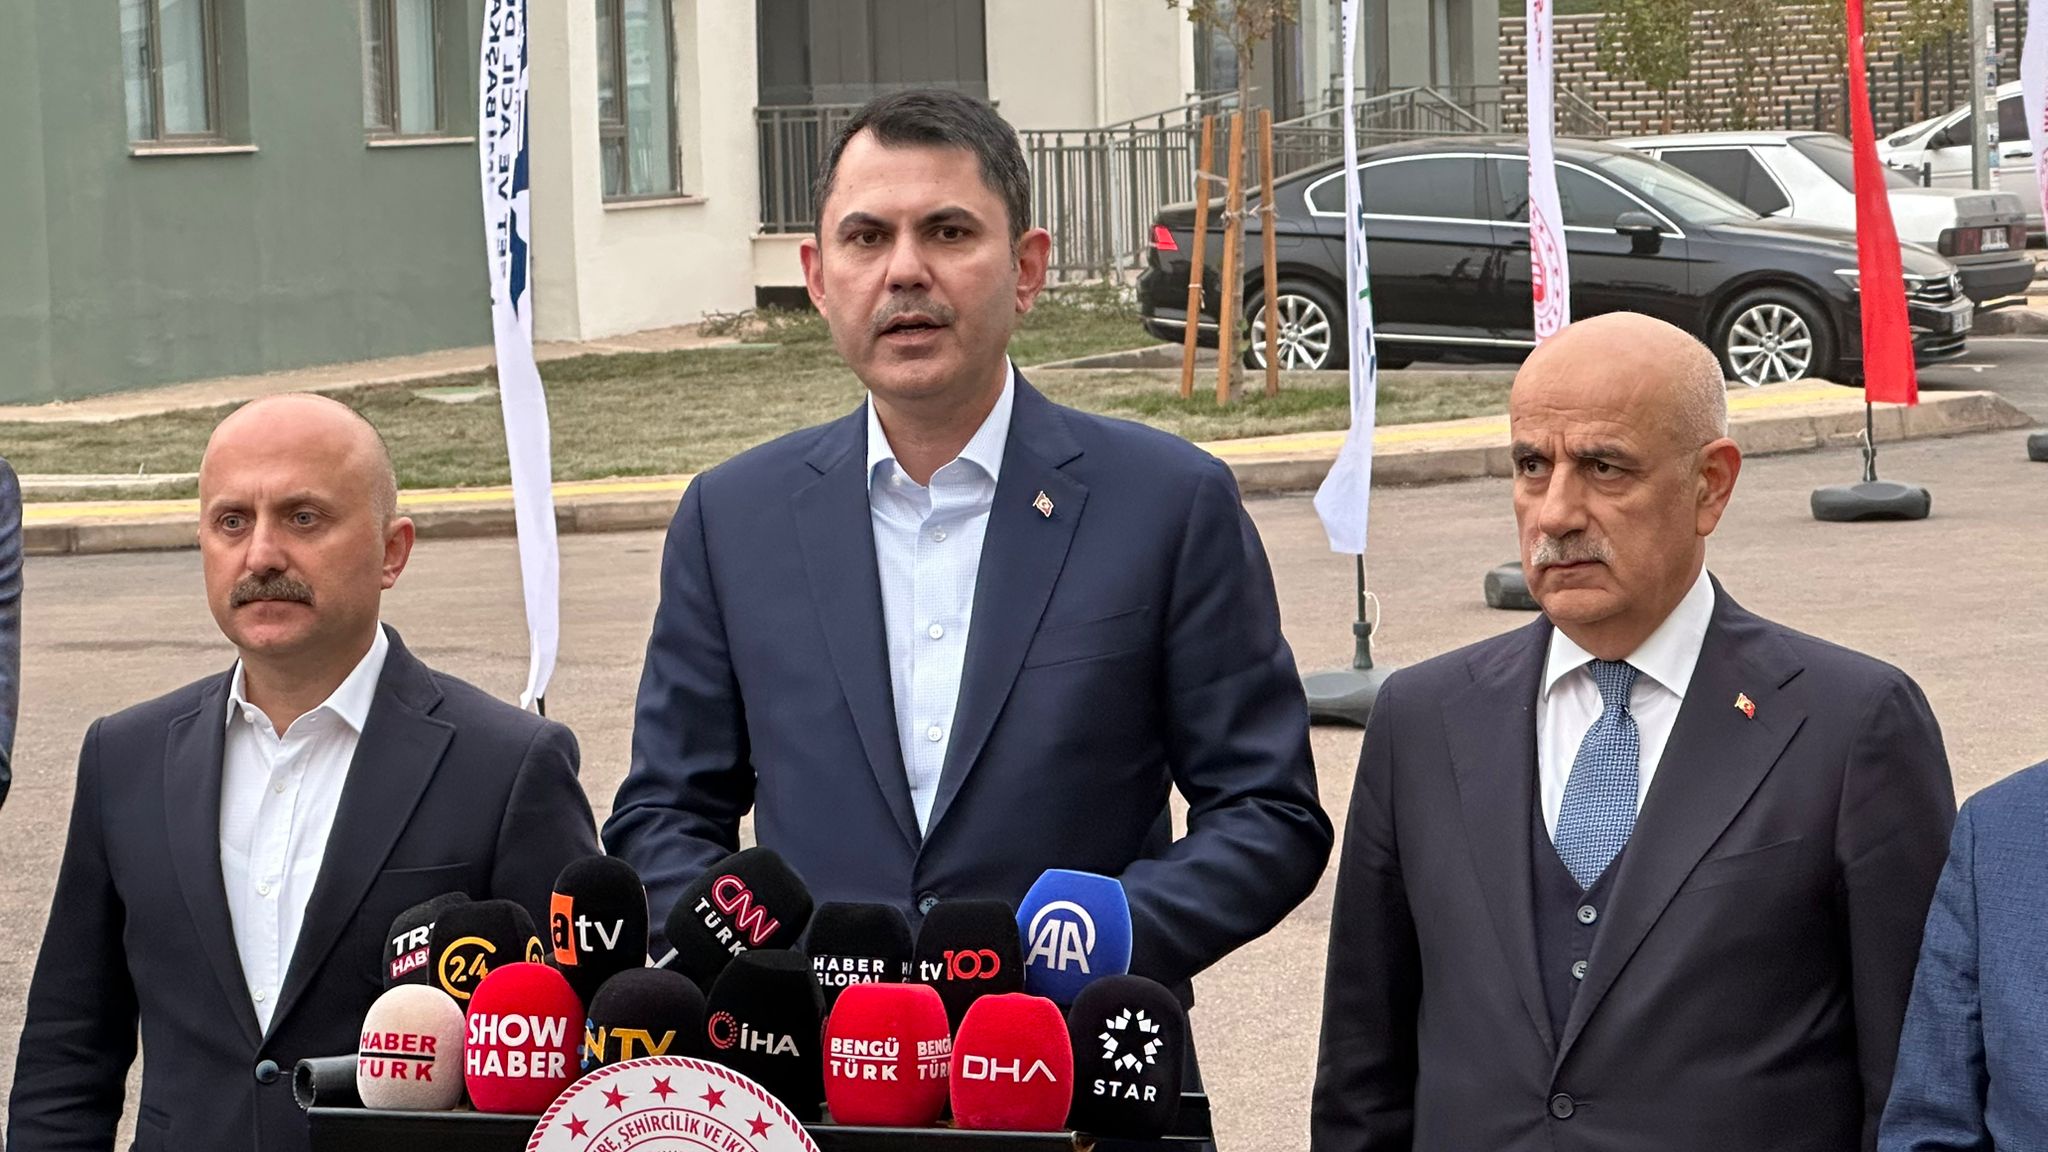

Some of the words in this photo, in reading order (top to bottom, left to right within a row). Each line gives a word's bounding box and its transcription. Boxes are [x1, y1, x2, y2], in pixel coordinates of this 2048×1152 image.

[711, 874, 781, 945] CNN
[552, 912, 624, 952] atv
[694, 897, 747, 957] TÜRK
[1026, 919, 1091, 975] AA
[392, 949, 429, 977] HAB
[449, 953, 488, 982] 24
[813, 957, 885, 973] HABER
[361, 1032, 437, 1054] HABER
[468, 1013, 567, 1048] SHOW
[583, 1025, 676, 1063] NTV
[740, 1023, 800, 1057] İHA
[831, 1037, 899, 1057] BENGÜ
[466, 1049, 566, 1079] HABER
[830, 1058, 898, 1081] TÜRK
[962, 1055, 1057, 1083] DHA
[1093, 1079, 1158, 1102] STAR
[617, 1112, 701, 1146] ŞEHİRCİLİK
[703, 1122, 723, 1144] VE
